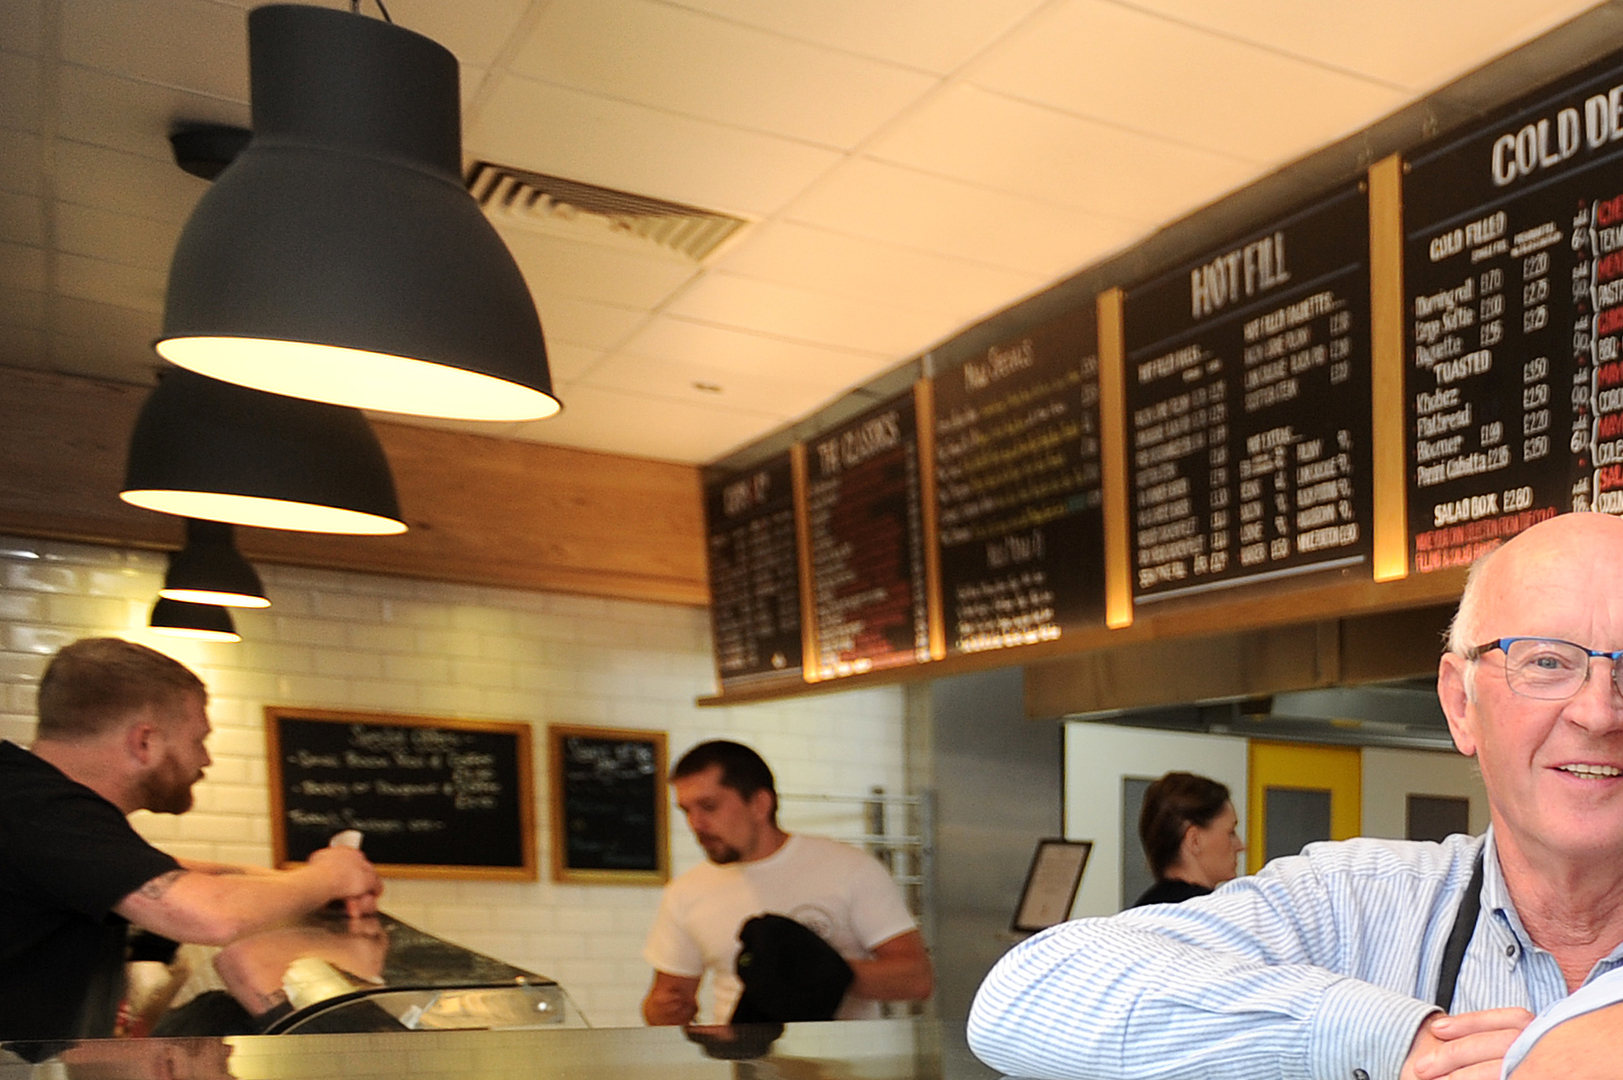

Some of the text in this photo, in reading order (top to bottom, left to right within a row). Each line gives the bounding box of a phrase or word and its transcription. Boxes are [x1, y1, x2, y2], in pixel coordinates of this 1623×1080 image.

[1492, 107, 1580, 187] COLD
[1434, 492, 1499, 527] SALAD BOX
